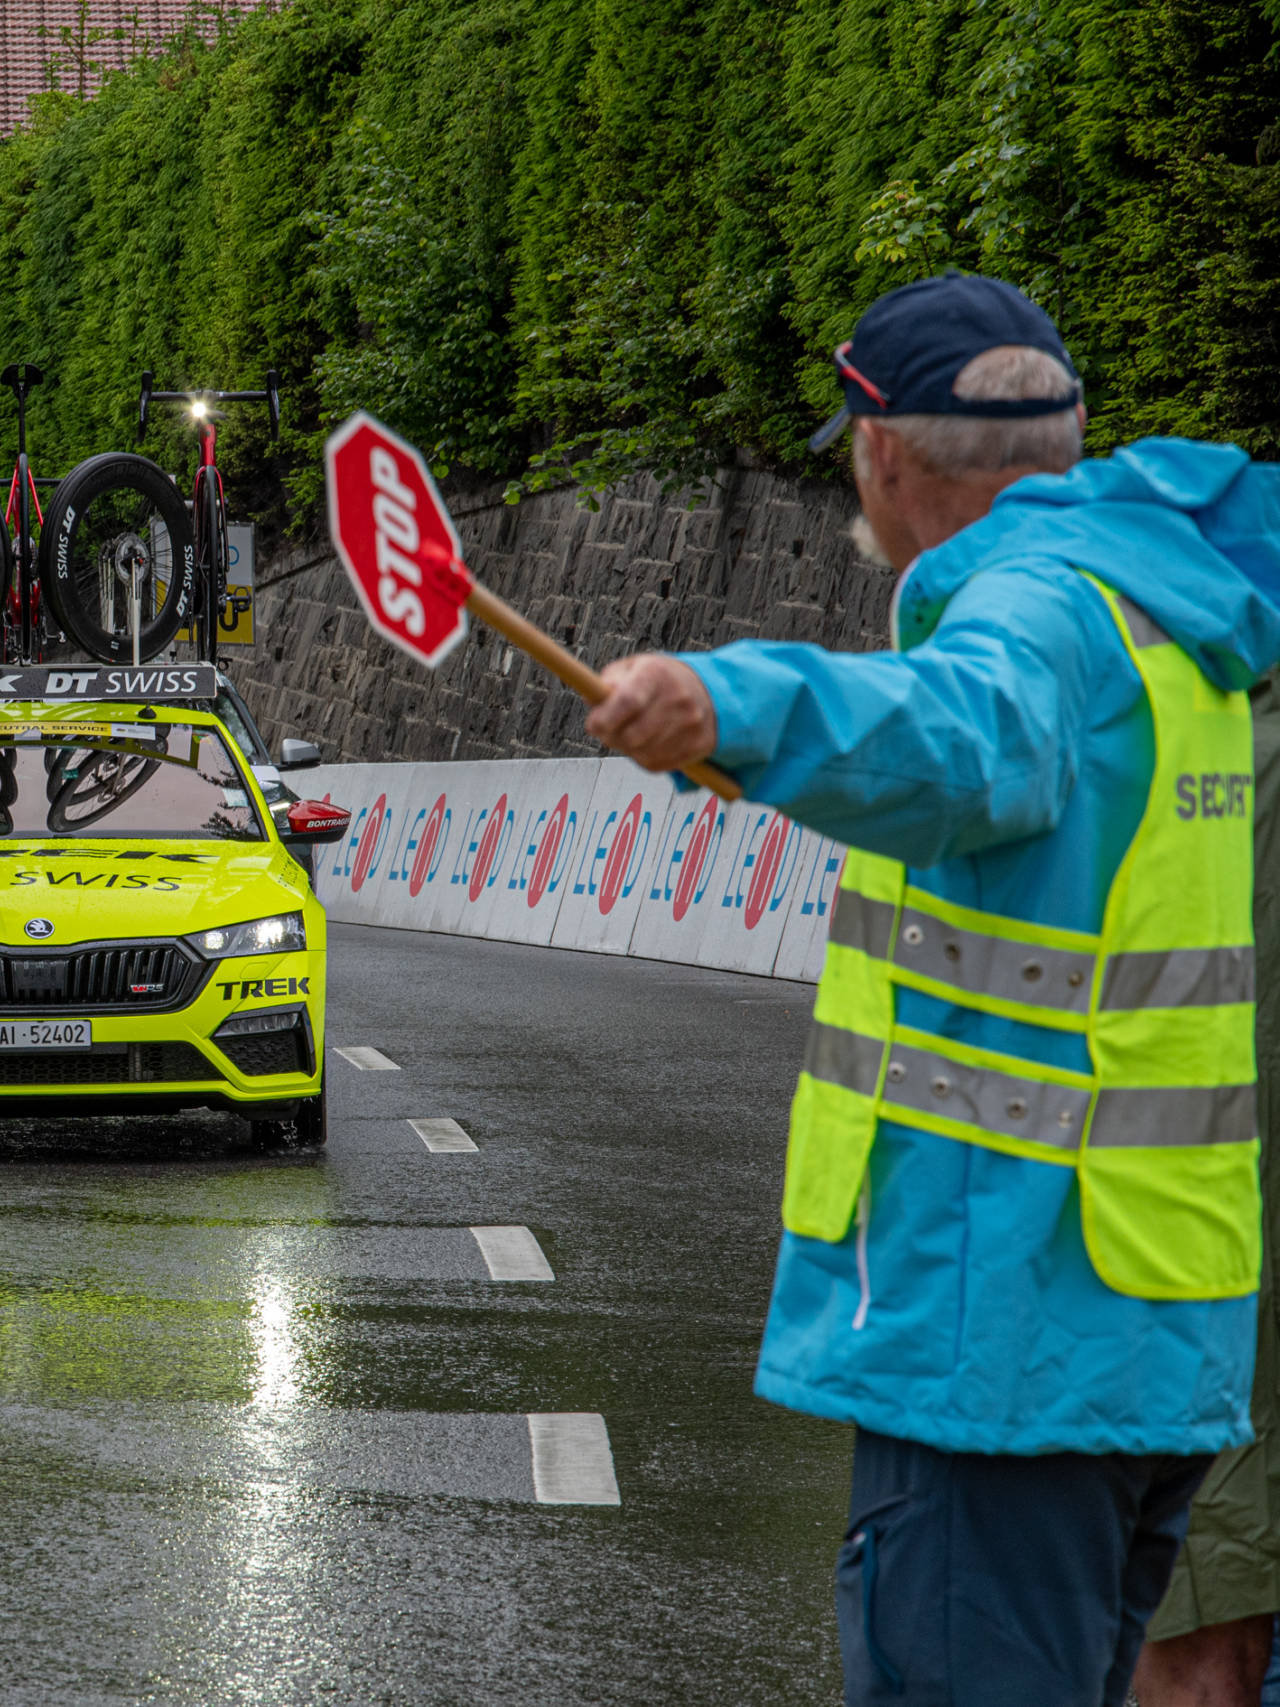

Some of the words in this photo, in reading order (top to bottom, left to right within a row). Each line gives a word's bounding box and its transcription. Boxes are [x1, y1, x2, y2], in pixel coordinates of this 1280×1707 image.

[370, 445, 426, 638] STOP
[45, 673, 97, 694] DT
[105, 671, 198, 694] SWISS
[52, 724, 108, 733] SERVICE
[10, 871, 182, 892] SWISS
[216, 977, 310, 1001] TREK
[30, 1025, 85, 1044] 52402
